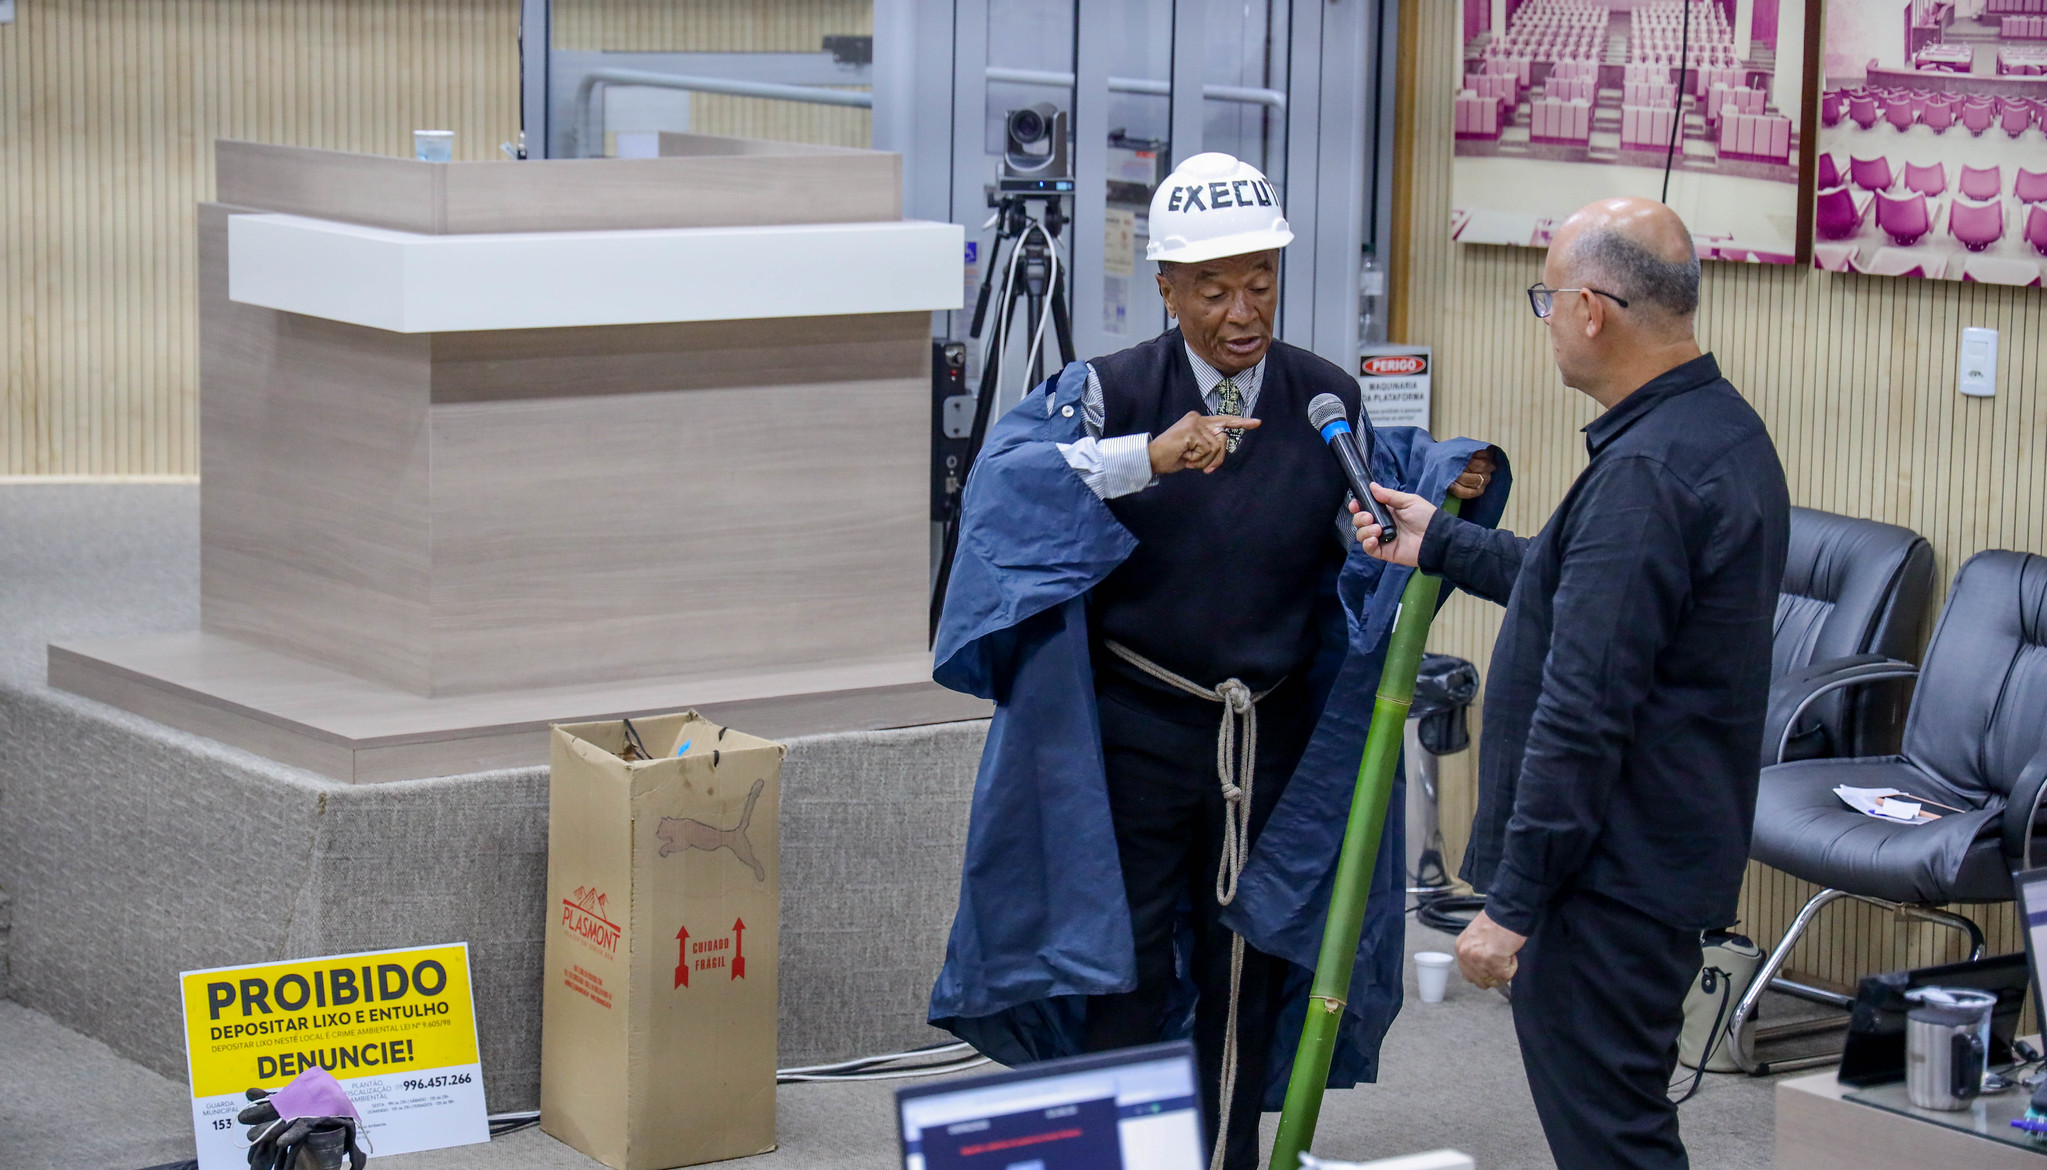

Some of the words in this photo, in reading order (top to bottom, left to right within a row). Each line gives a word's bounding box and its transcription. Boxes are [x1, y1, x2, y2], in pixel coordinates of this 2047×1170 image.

[1372, 359, 1417, 372] PERIGO
[1374, 393, 1424, 403] PLATAFORMA
[562, 906, 620, 953] PLASMONT
[692, 937, 729, 954] CUIDADO
[695, 955, 725, 971] FRÁGIL
[207, 960, 447, 1020] PROIBIDO
[210, 1017, 309, 1040] DEPOSITAR
[313, 1012, 351, 1028] LIXO
[356, 1010, 365, 1023] E
[369, 1001, 449, 1022] ENTULHO
[211, 1042, 254, 1053] DEPOSITAR
[256, 1038, 273, 1047] LIXO
[300, 1032, 324, 1042] LOCAL
[331, 1028, 355, 1039] CRIME
[357, 1024, 399, 1035] AMBIENTAL
[257, 1039, 414, 1079] DENUNCIE!
[352, 1079, 383, 1089] PLANTÃO
[403, 1073, 472, 1091] 996.457.266
[202, 1107, 239, 1116] MUNICIPAL
[206, 1100, 235, 1109] GUARDA
[212, 1118, 232, 1130] 153
